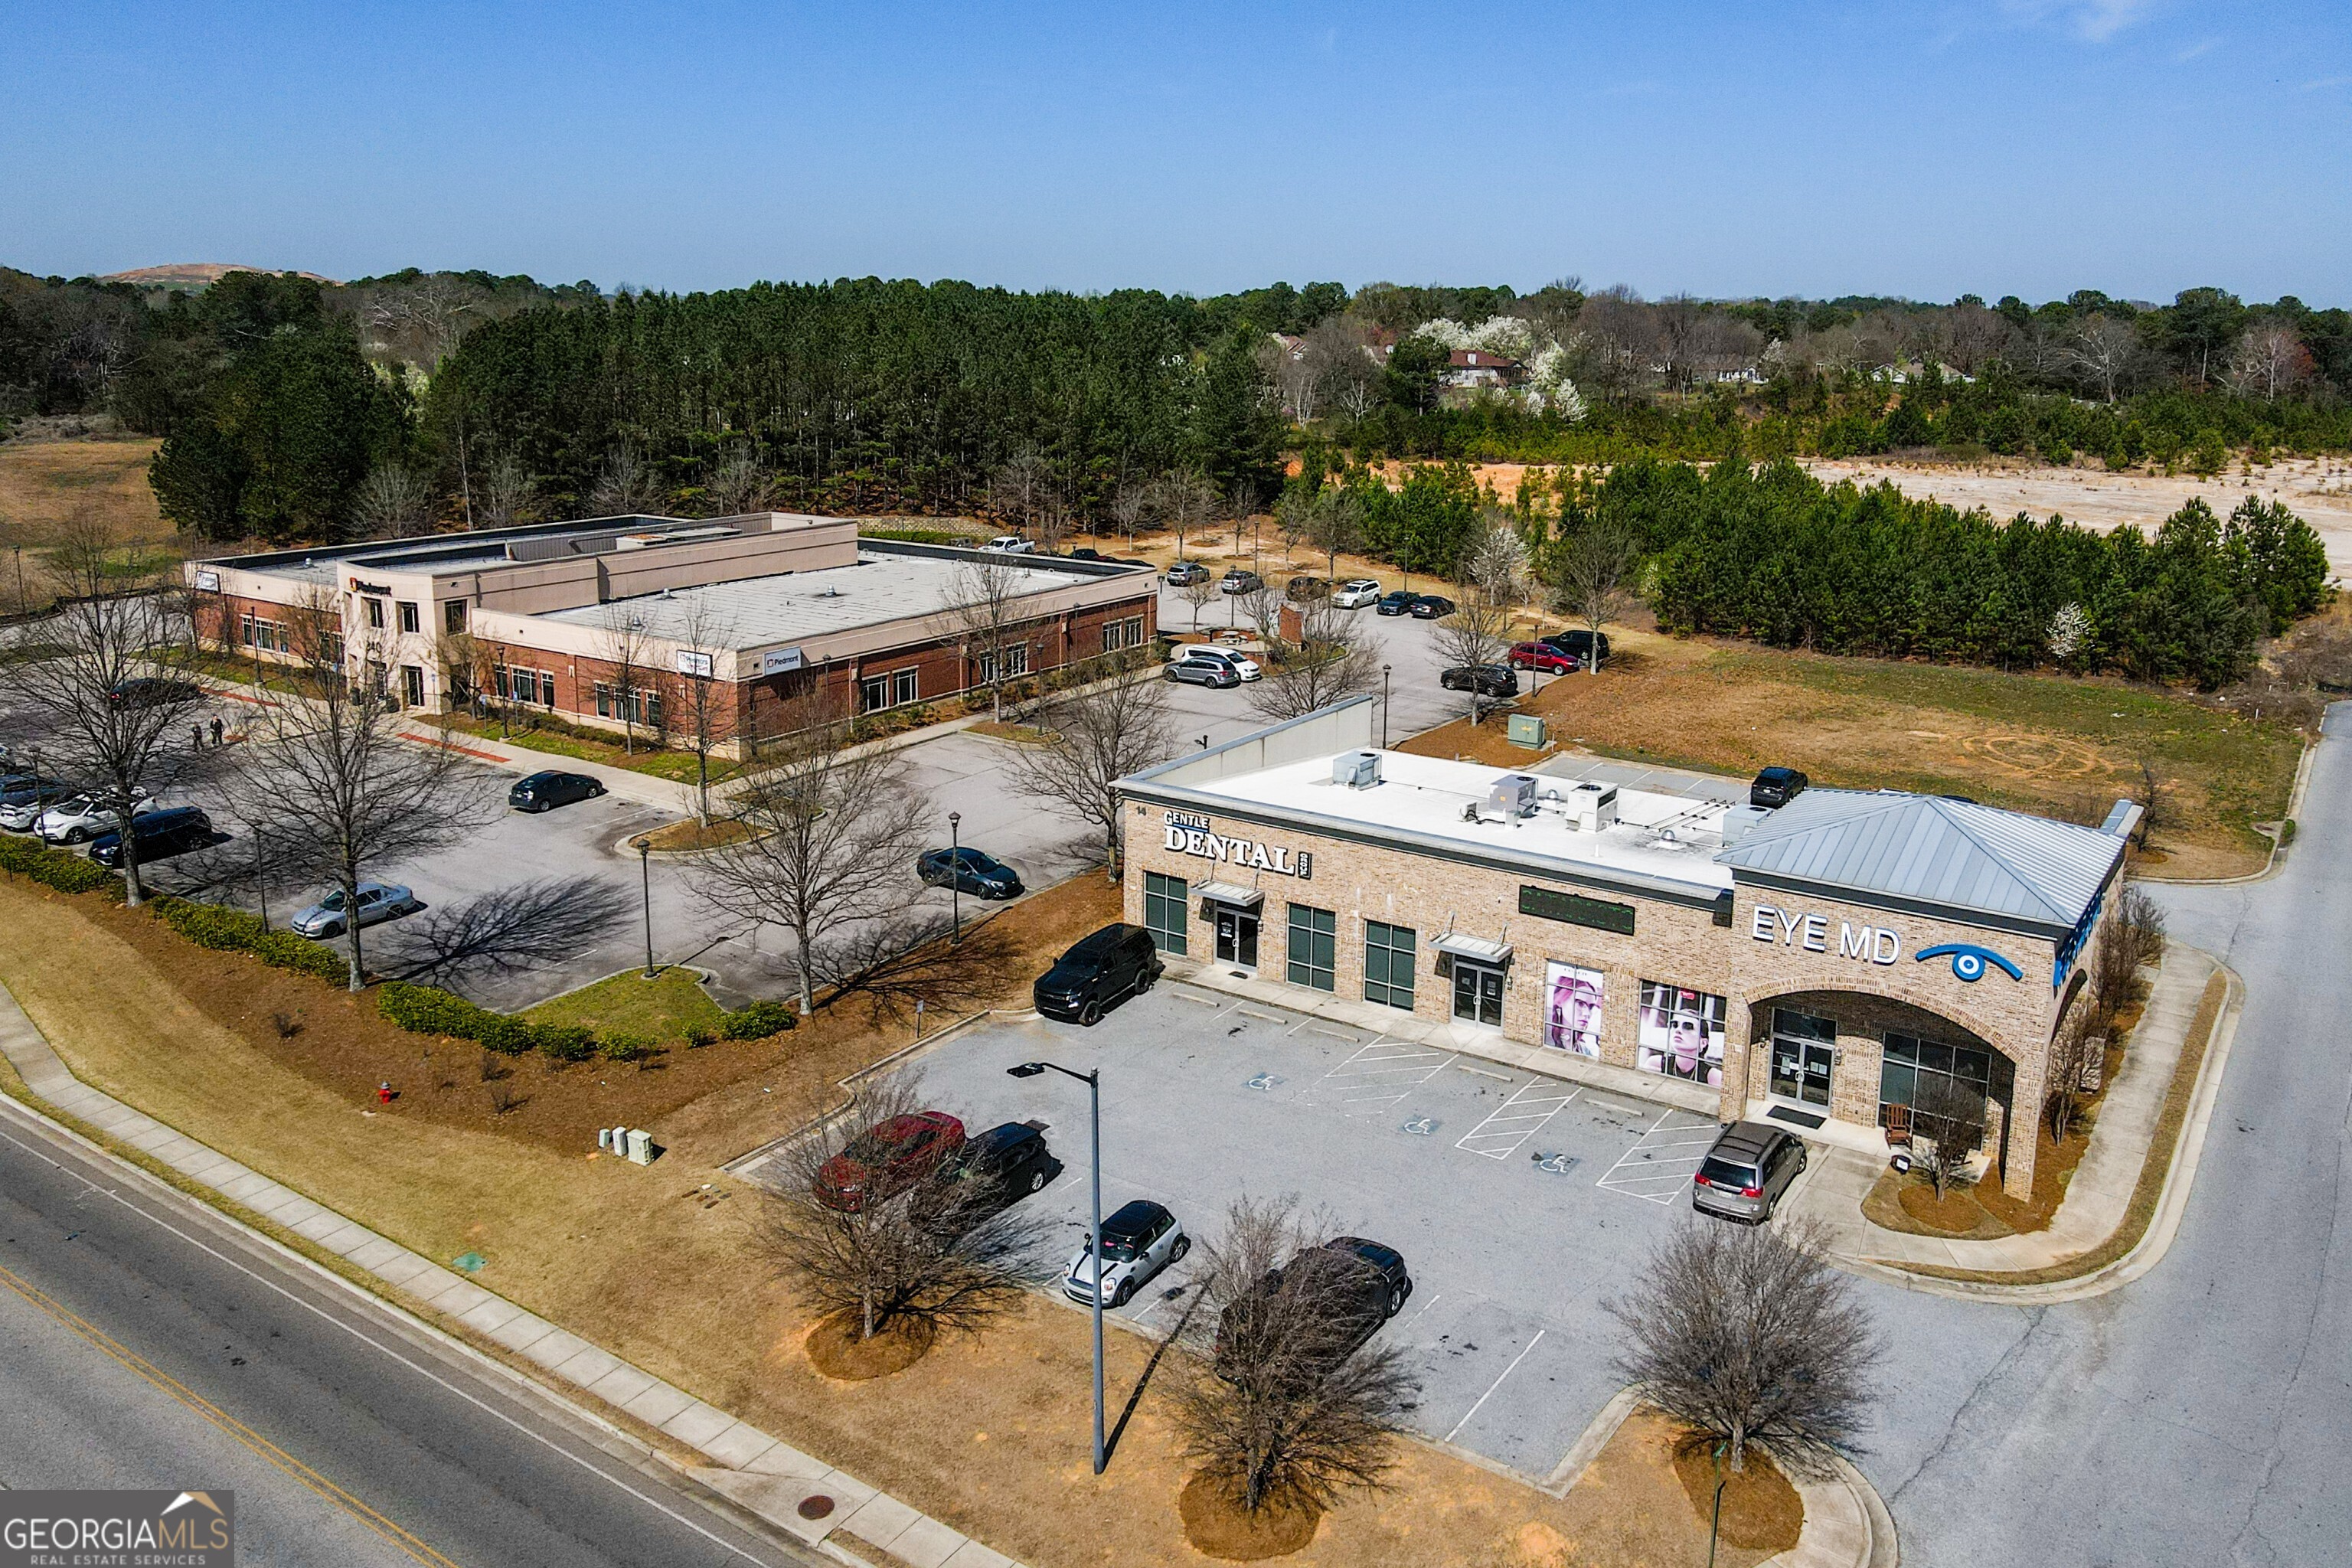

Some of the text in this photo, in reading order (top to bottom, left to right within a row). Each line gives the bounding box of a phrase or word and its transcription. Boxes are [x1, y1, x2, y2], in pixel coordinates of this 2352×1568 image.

[774, 655, 799, 666] Piedmont
[1163, 810, 1210, 829] GENTLE
[1164, 825, 1295, 875] DENTAL
[1753, 905, 1900, 965] EYE MD
